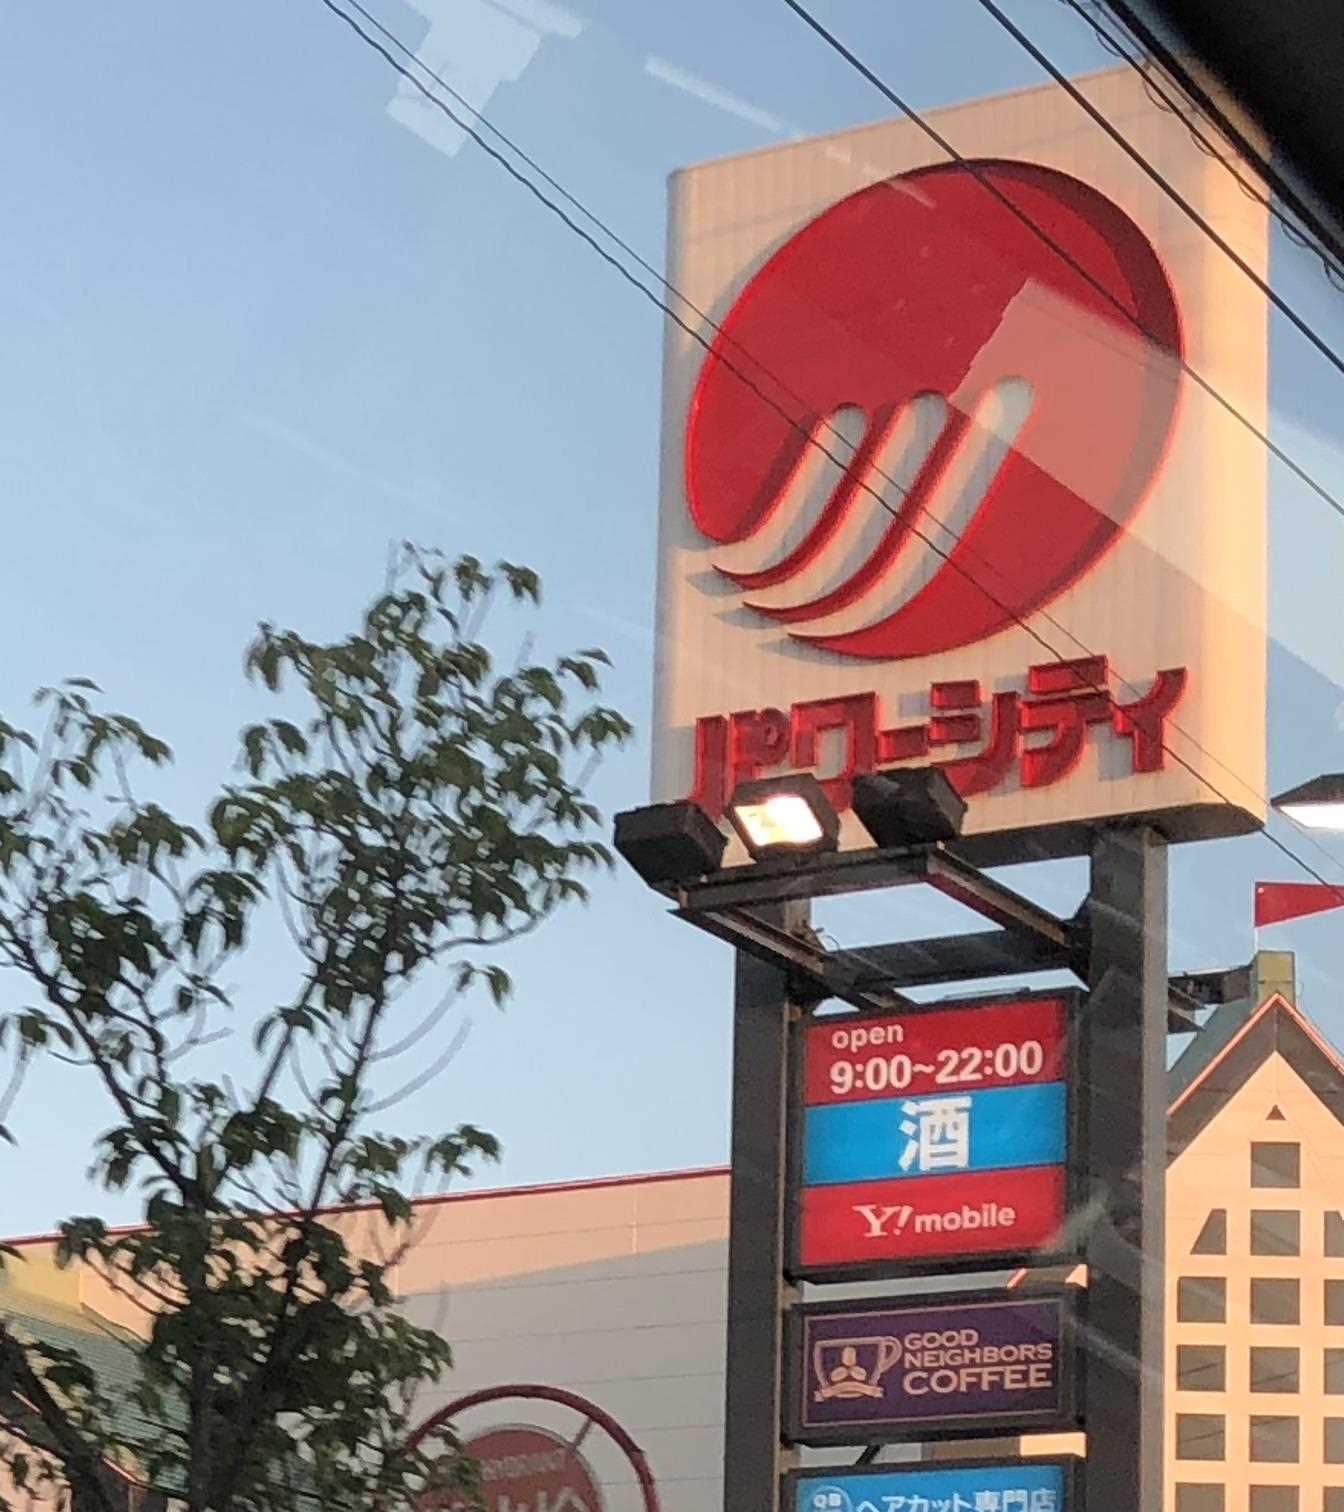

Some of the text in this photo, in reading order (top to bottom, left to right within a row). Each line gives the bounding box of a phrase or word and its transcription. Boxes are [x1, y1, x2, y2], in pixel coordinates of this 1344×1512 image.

[831, 1023, 904, 1052] open
[897, 1095, 973, 1171] 酒
[903, 1329, 980, 1350] GOOD
[903, 1342, 1053, 1369] NEIGHBORS
[901, 1363, 1053, 1396] COFFEE
